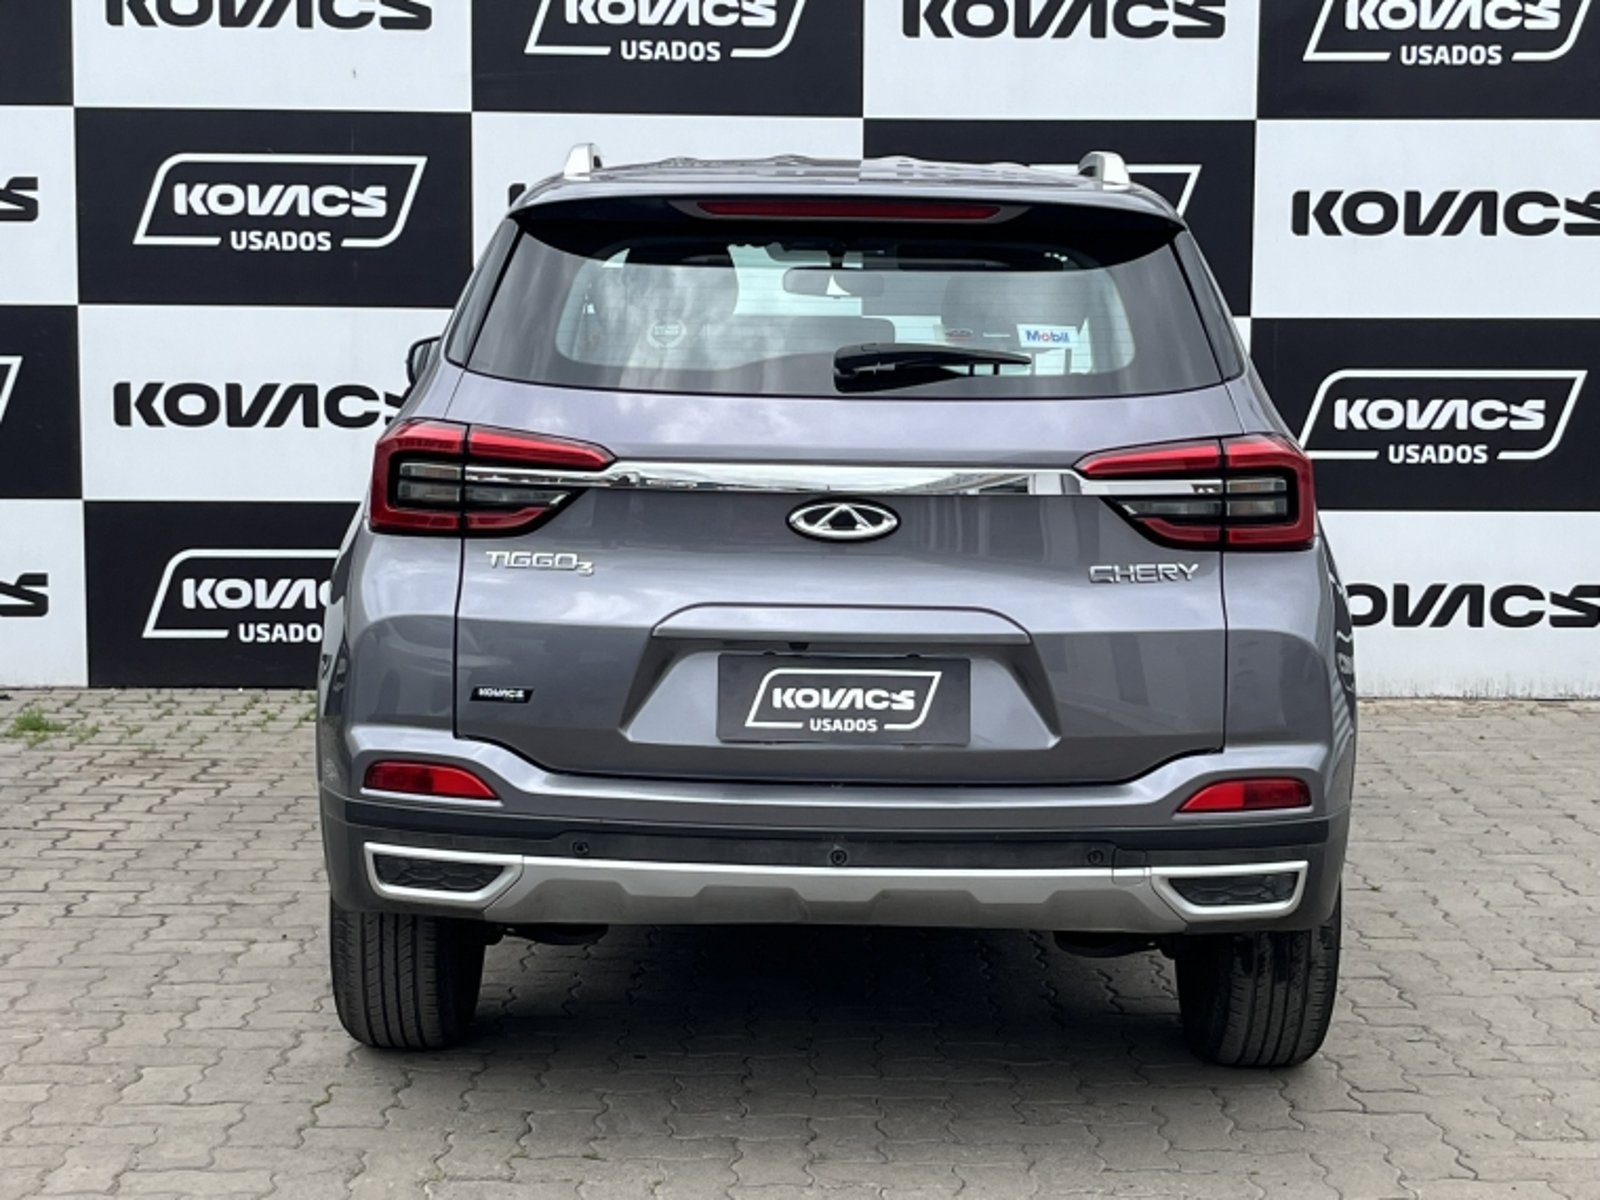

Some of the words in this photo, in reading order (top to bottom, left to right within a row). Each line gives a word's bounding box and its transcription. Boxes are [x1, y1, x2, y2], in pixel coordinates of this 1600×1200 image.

[106, 0, 431, 30] KOVACS
[565, 0, 777, 26] KOVACS
[903, 0, 1226, 38] KOVACS
[1345, 0, 1560, 31] KOVACS
[620, 40, 721, 61] USADOS
[1400, 45, 1503, 65] USADOS
[173, 183, 388, 217] KOVACS
[1291, 190, 1600, 236] KOVACS
[230, 230, 332, 252] USADOS
[1026, 330, 1070, 342] Mobil
[1334, 399, 1547, 431] KOVACS
[1388, 444, 1488, 464] USADOS
[1089, 563, 1199, 583] CHERY
[182, 578, 331, 609] KOVA
[1345, 583, 1600, 628] OVACS
[238, 623, 323, 643] USADO
[772, 687, 916, 711] KOVACS
[809, 718, 878, 732] USADOS
